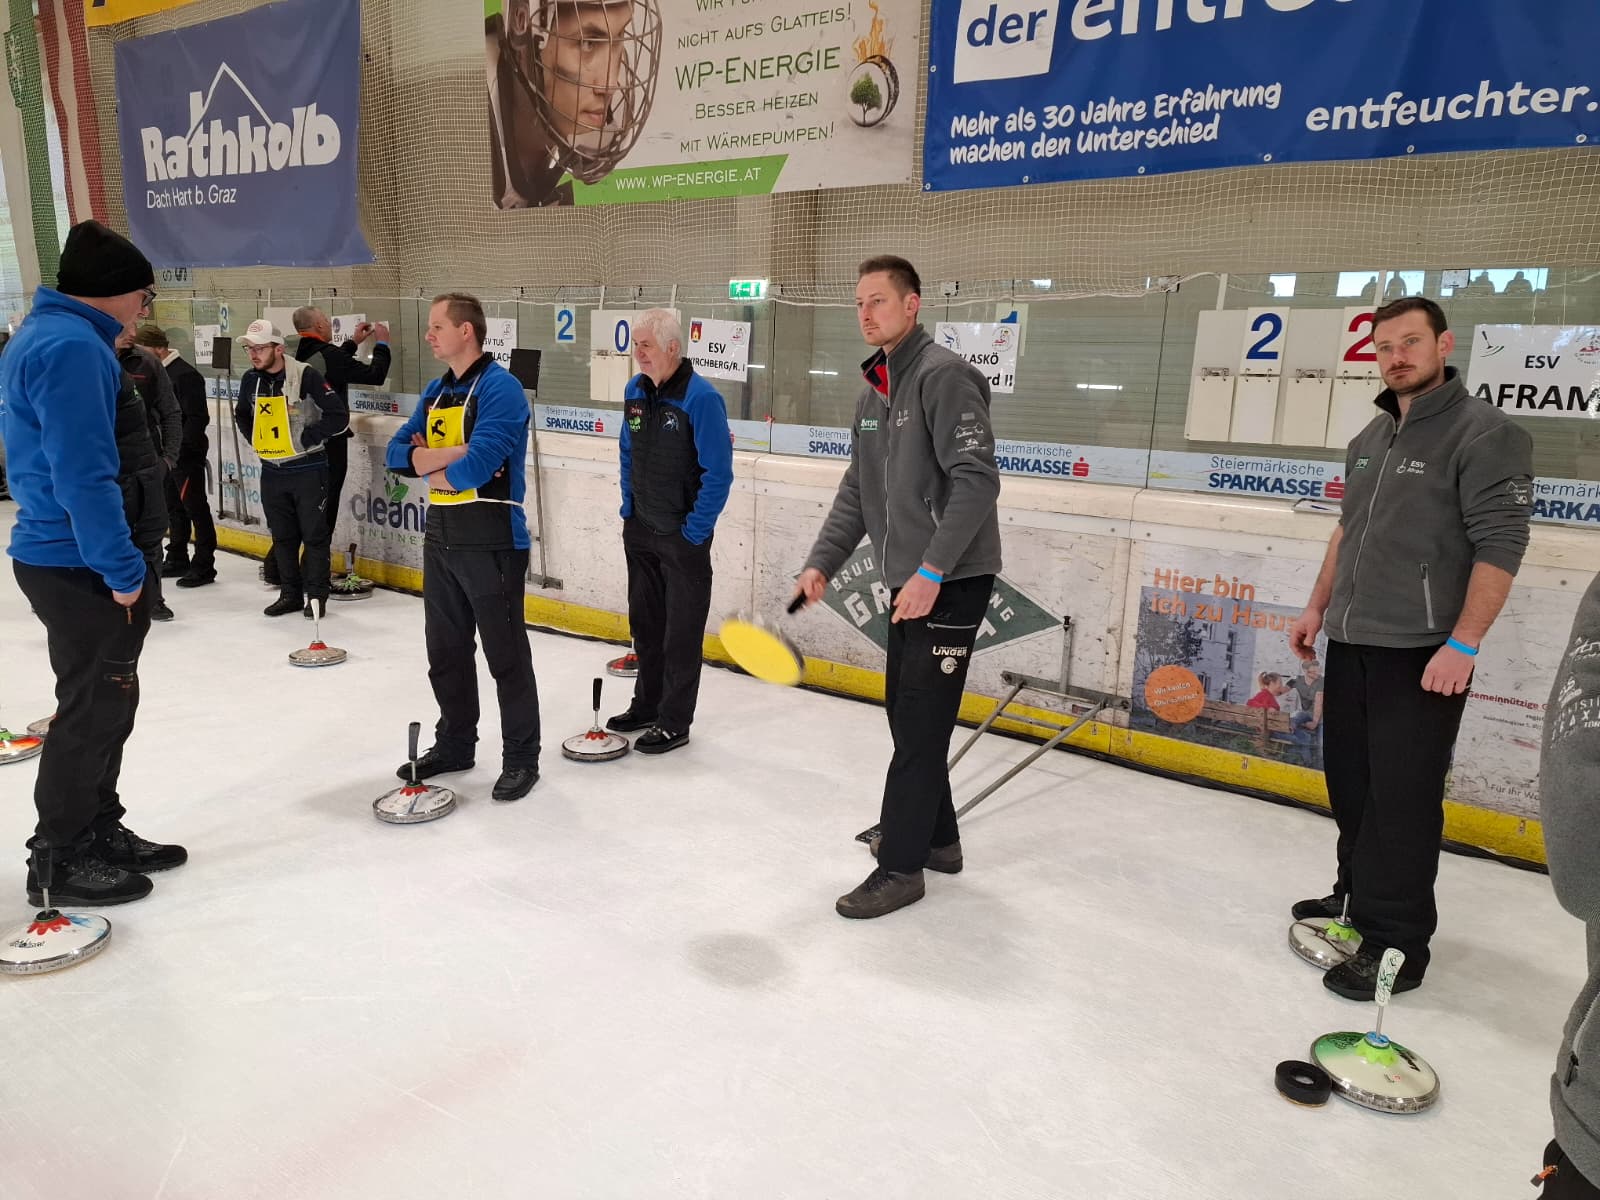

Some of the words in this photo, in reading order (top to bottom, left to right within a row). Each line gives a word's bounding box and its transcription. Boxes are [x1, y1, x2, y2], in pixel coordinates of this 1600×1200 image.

[677, 31, 719, 49] NICHT
[724, 23, 764, 41] AUFS
[771, 3, 851, 33] GLATTEIS!
[967, 3, 1048, 47] der
[675, 46, 841, 91] WP-ENERGIE
[695, 99, 755, 119] BESSER
[763, 91, 819, 112] HEIZEN
[951, 110, 999, 138] Mehr
[1005, 106, 1036, 133] als
[1042, 104, 1075, 128] 30
[1081, 96, 1147, 126] Jahre
[1154, 82, 1282, 119] Erfahrung
[1305, 79, 1599, 131] entfeuchter.
[141, 91, 341, 182] Rathkolb
[680, 139, 701, 153] MIT
[707, 121, 834, 150] WÄRMEPUMPEN!
[950, 137, 1025, 165] machen
[1031, 133, 1070, 158] den
[1077, 113, 1221, 154] Unterschied
[615, 167, 761, 190] WWW.WP-ENERGIE.AT
[147, 187, 171, 208] Dach
[172, 186, 192, 205] Hart
[195, 184, 206, 204] b.
[208, 183, 237, 204] Graz
[557, 309, 574, 341] 2
[614, 319, 630, 353] 0
[1246, 312, 1283, 360] 2
[1343, 312, 1378, 362] 2
[708, 342, 726, 354] ESV
[969, 352, 999, 365] ASKÖ
[1524, 355, 1560, 369] ESV
[546, 417, 594, 431] SPARKASSE
[996, 441, 1073, 457] eiermärkische
[1410, 460, 1426, 468] ESV
[994, 456, 1071, 475] PARKASSE
[1210, 455, 1325, 476] Steiermärkische
[1208, 472, 1322, 497] SPARKASSE
[351, 487, 426, 533] cleani
[1153, 568, 1207, 593] Hier
[1213, 574, 1256, 601] bin
[1150, 592, 1187, 617] ich
[1194, 602, 1223, 623] zu
[1467, 690, 1538, 710] Gemeinnützige
[1508, 787, 1520, 797] Ihr
